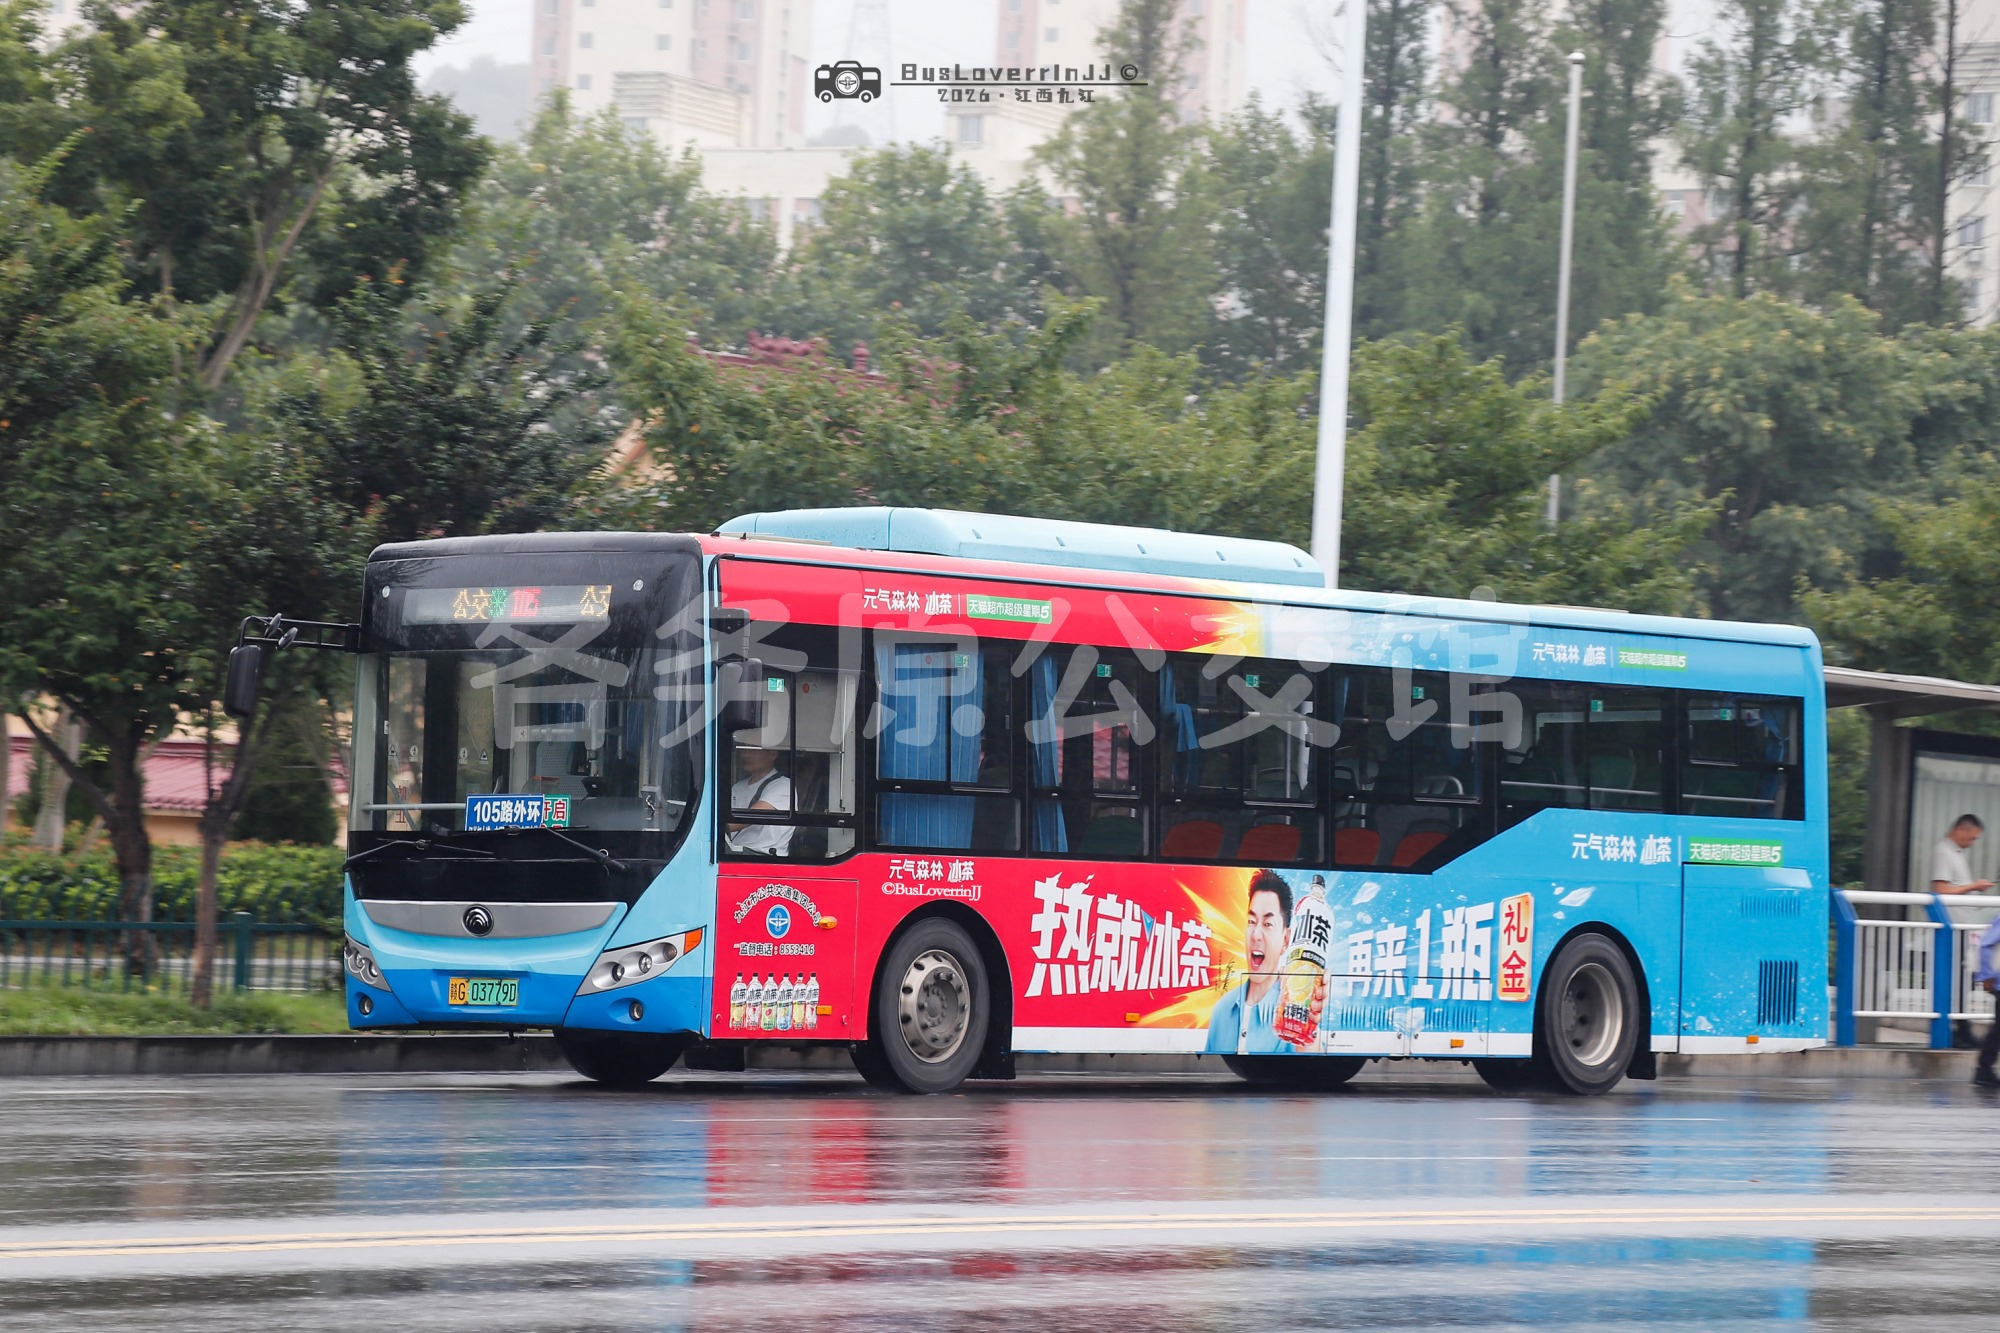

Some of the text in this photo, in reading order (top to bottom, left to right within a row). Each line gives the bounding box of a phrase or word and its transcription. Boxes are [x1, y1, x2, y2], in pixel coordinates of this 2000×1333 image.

[863, 588, 1049, 619] 元气森林 冰茶 天猫超市超级星期5
[1532, 642, 1581, 664] 元气森林
[1583, 644, 1607, 667] 冰茶
[473, 800, 541, 823] 105路外环
[1571, 833, 1782, 865] 元气森林 冰茶 天猫超市超级星期5
[889, 858, 975, 883] 元气森林 冰茶
[1024, 871, 1212, 998] 热就冰茶
[1502, 902, 1528, 993] 礼金
[1347, 901, 1494, 1001] 再来1瓶
